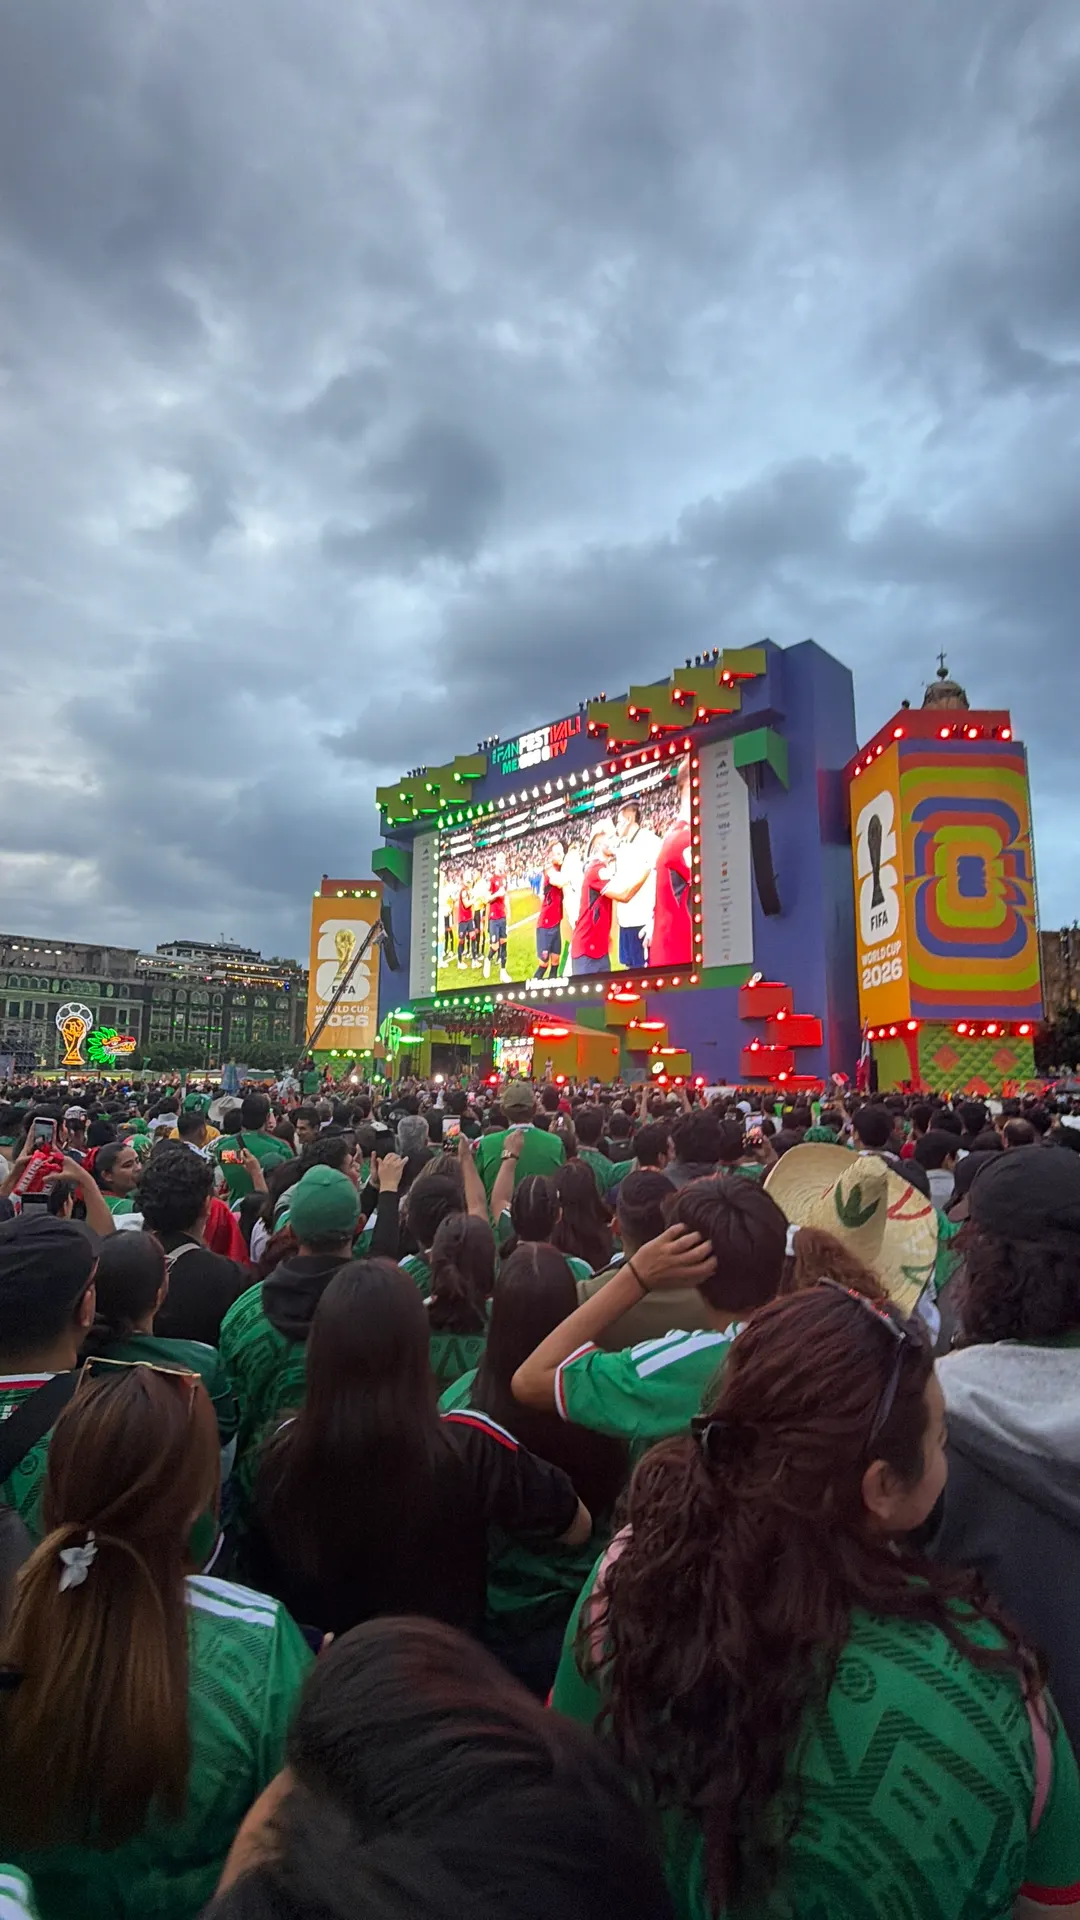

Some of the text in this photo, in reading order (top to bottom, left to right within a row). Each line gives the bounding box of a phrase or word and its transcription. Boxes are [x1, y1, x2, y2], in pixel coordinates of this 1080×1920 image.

[502, 748, 541, 775] MEXO
[870, 910, 889, 932] FIFA
[861, 940, 902, 967] WORLD CUP
[862, 957, 903, 990] 2026
[331, 985, 356, 994] FFA
[315, 1004, 370, 1014] WLD CUP
[314, 1014, 369, 1027] 2026
